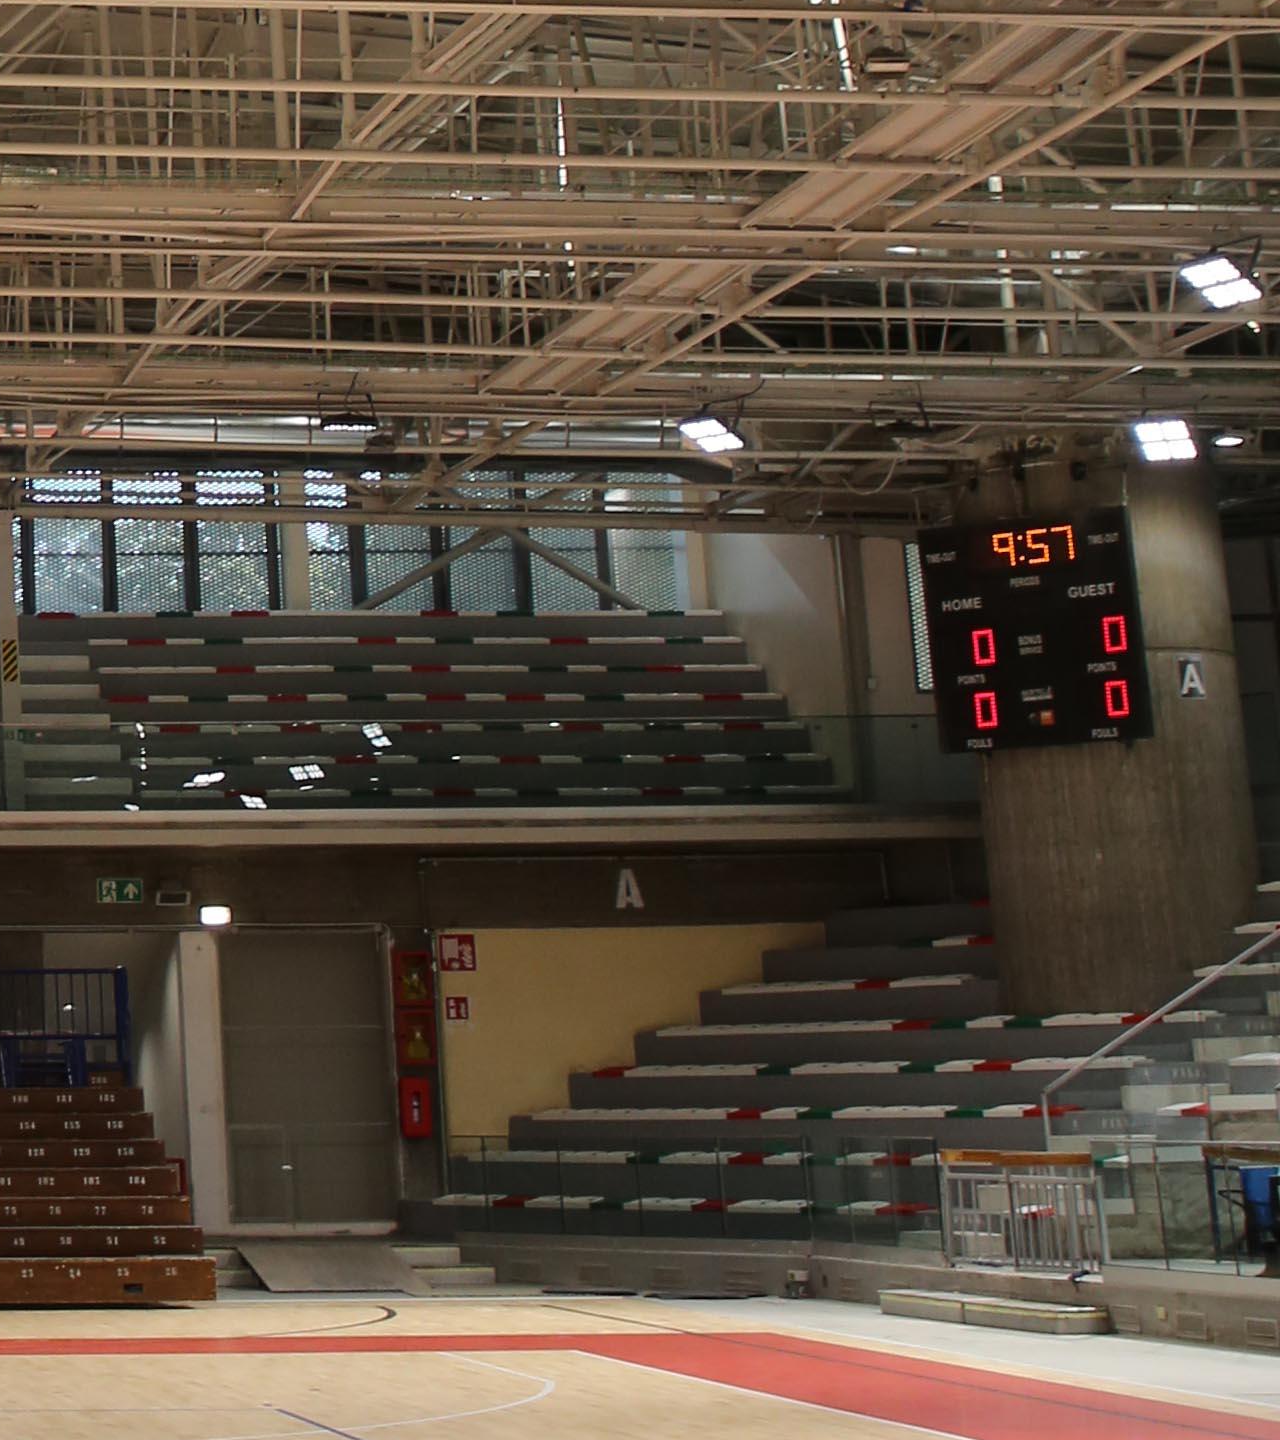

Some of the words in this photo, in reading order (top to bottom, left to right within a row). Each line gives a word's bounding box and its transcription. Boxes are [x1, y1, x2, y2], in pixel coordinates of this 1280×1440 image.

[992, 524, 1075, 567] 9:57
[942, 597, 983, 612] HOME
[1067, 582, 1115, 598] GUEST
[971, 628, 996, 665] 0
[1102, 615, 1128, 653] 0
[957, 673, 986, 685] POINTS
[1087, 661, 1117, 673] POINTS
[1180, 663, 1206, 697] A
[974, 691, 998, 728] 0
[1105, 680, 1130, 717] 0
[967, 737, 993, 748] FOULS
[1091, 727, 1118, 738] FOULS
[616, 868, 645, 908] A
